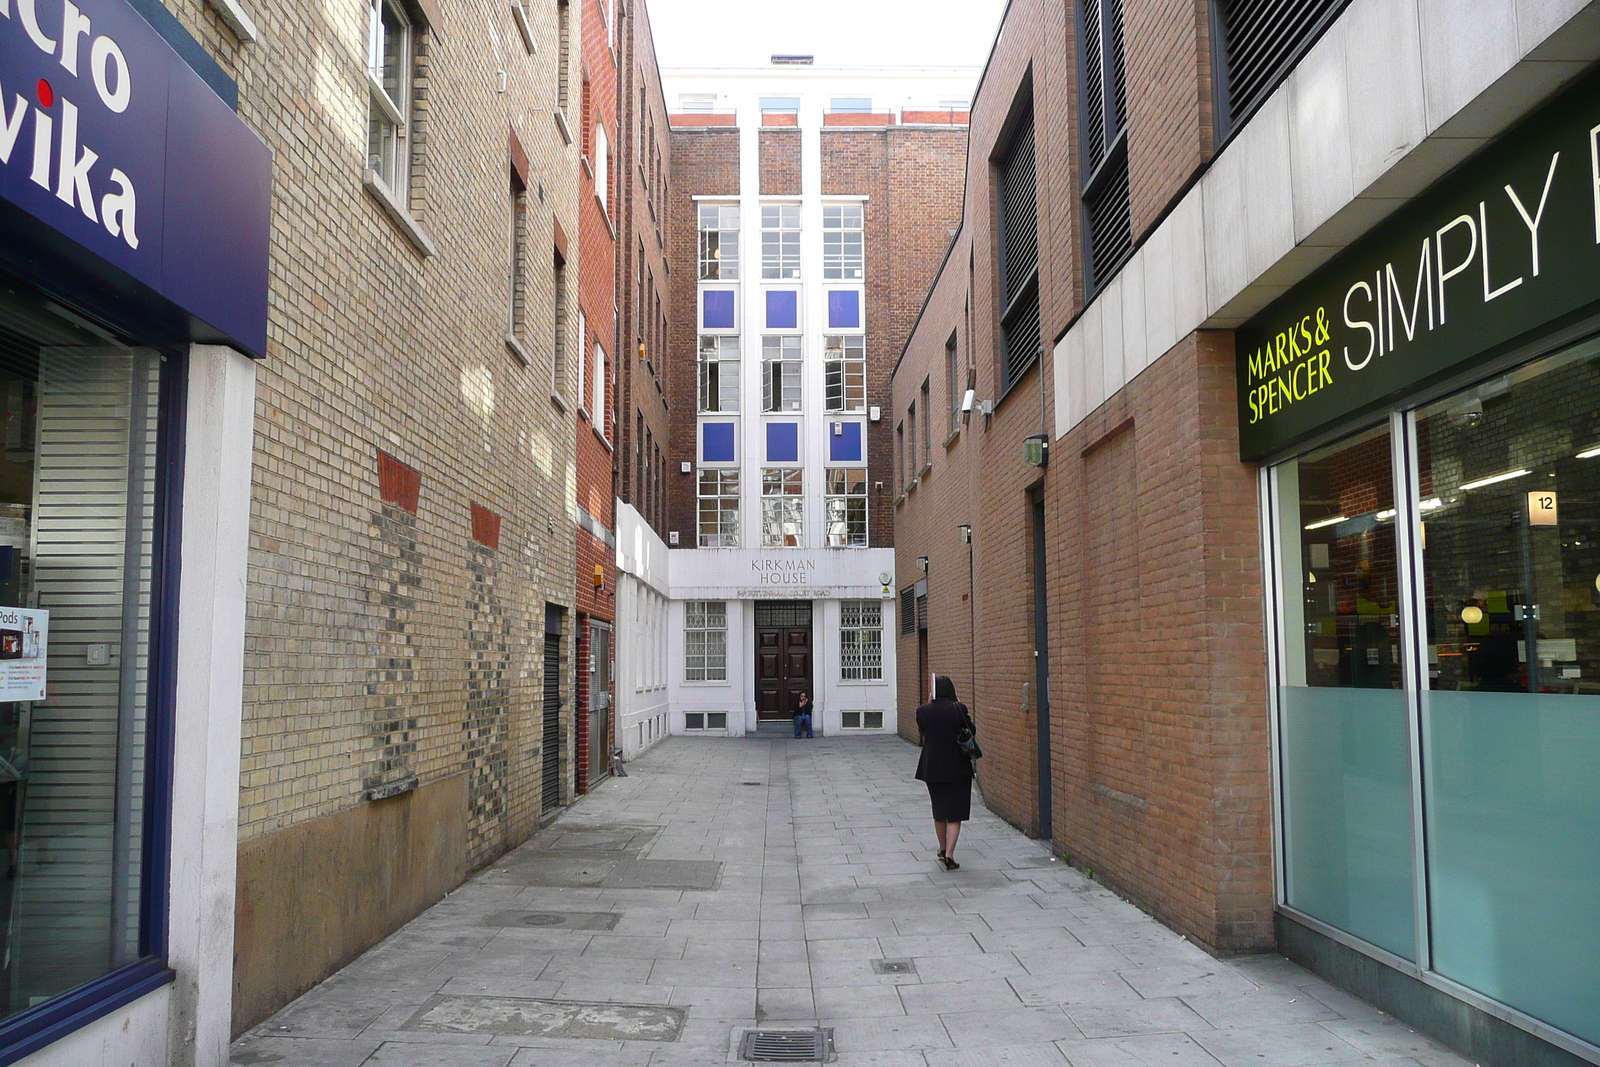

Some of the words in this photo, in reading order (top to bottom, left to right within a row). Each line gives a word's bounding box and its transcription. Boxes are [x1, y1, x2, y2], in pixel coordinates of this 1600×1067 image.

[0, 0, 131, 114] cro
[1343, 151, 1560, 371] SIMPLY
[1248, 315, 1312, 386] MARKS
[1315, 306, 1331, 346] &
[1248, 349, 1333, 424] SPENCER
[1538, 497, 1553, 510] 12
[751, 559, 815, 571] KIRKMAN
[760, 572, 807, 584] HOUSE
[788, 589, 811, 597] COURT
[813, 589, 831, 597] ROAD
